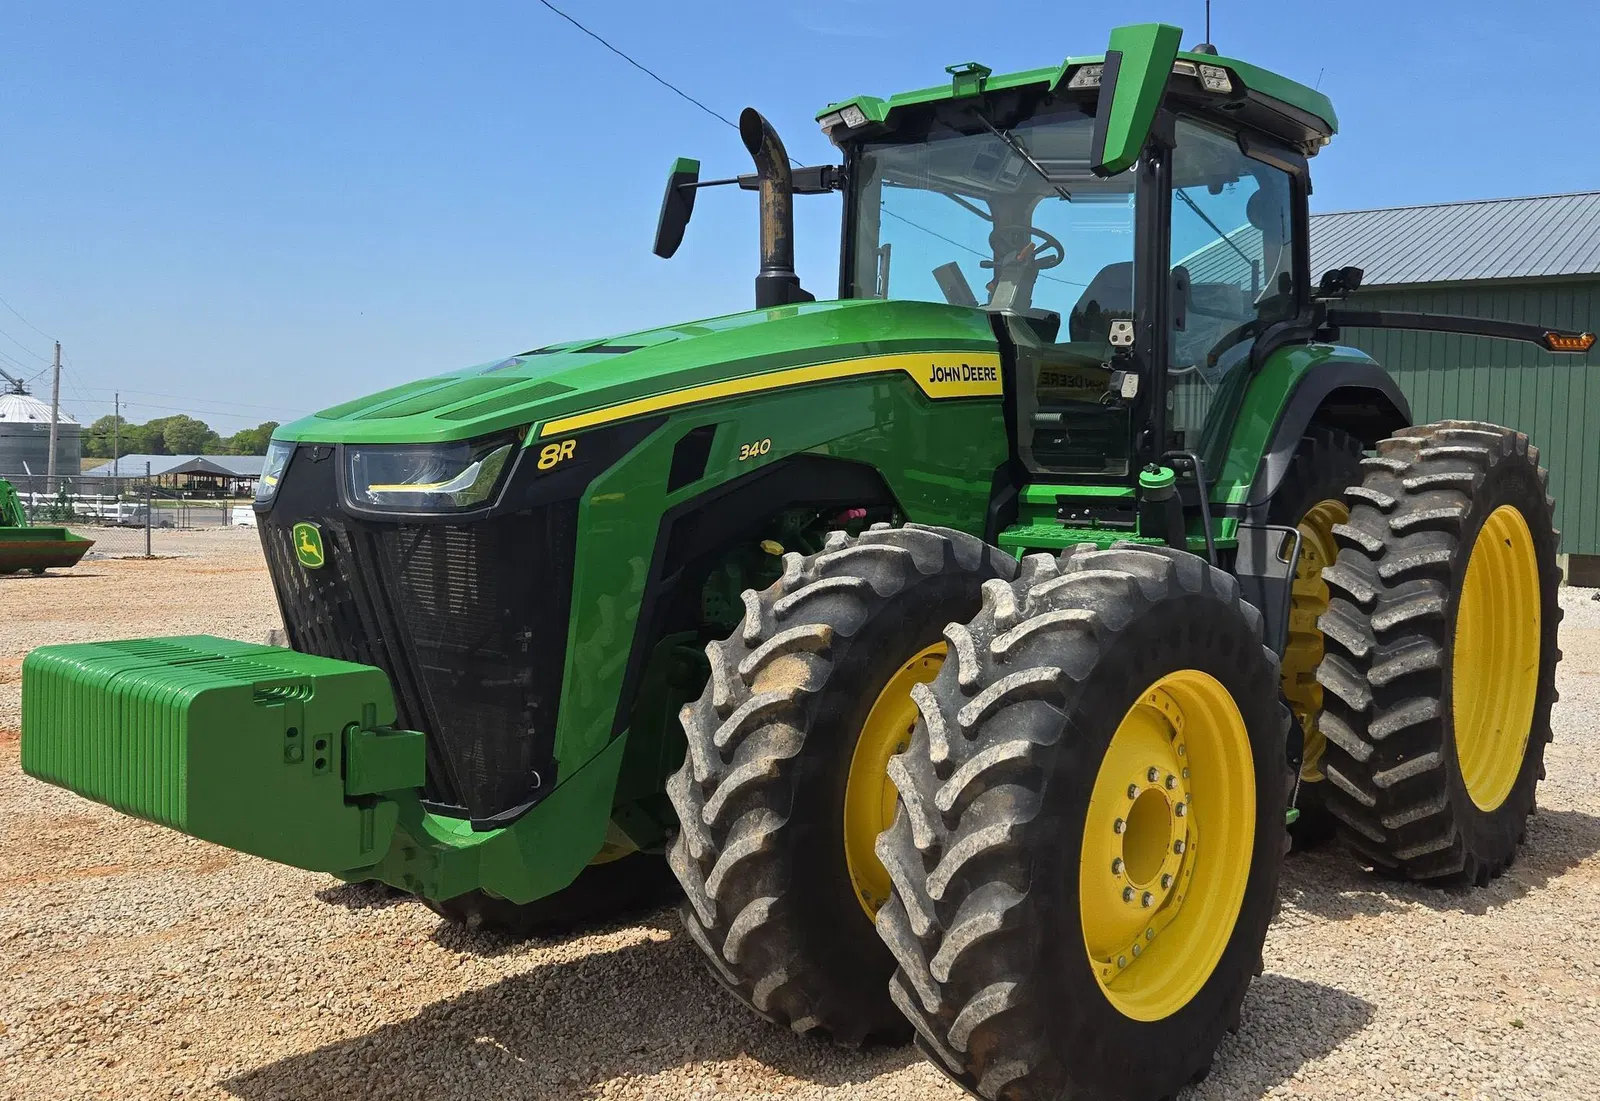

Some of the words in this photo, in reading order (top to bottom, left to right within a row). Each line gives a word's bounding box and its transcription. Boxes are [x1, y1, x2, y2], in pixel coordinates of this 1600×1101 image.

[929, 364, 960, 382] JOHN
[961, 364, 997, 381] DEERE
[537, 439, 577, 470] 8R
[739, 438, 771, 461] 340
